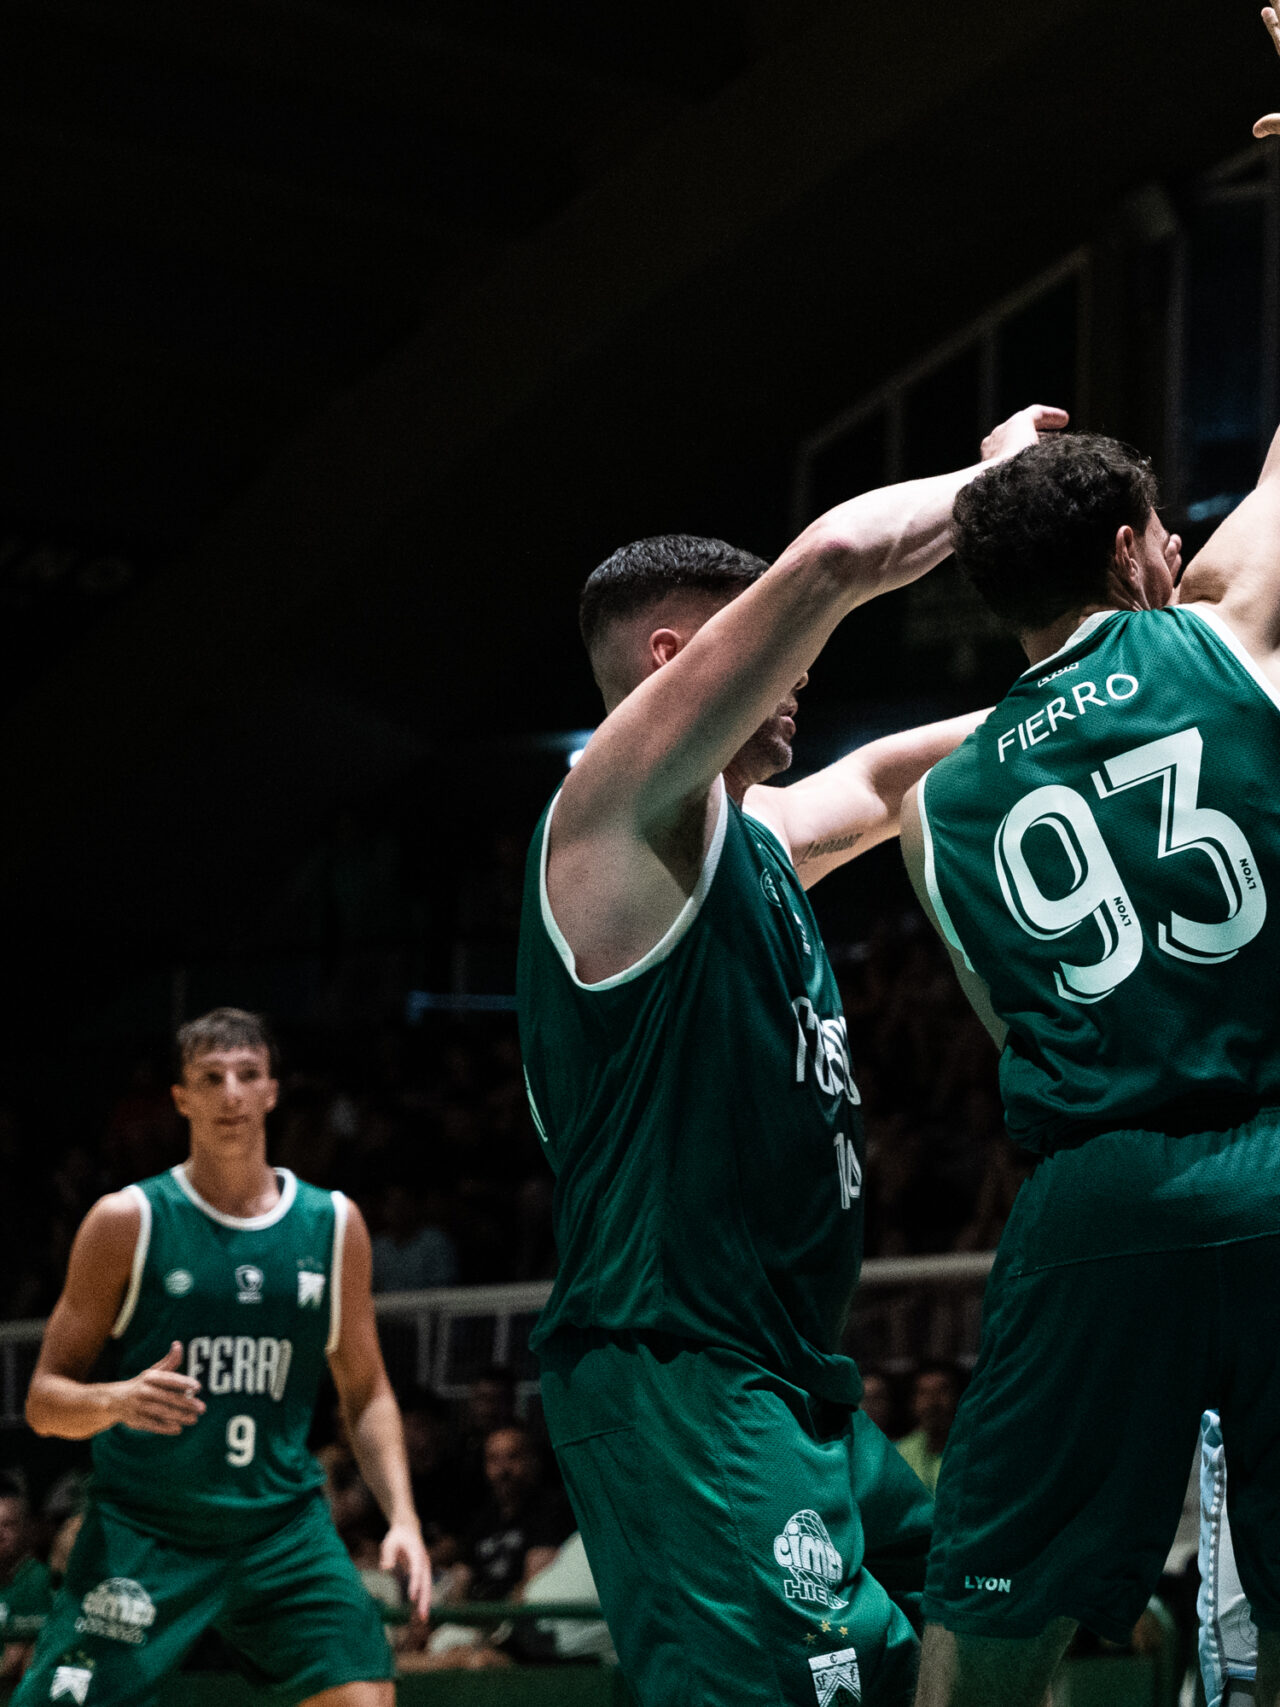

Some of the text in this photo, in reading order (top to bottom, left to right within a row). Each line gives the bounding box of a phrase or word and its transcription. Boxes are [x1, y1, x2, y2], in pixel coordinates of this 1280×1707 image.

[997, 673, 1140, 763] FIERRO
[994, 726, 1267, 1005] 93
[1239, 858, 1257, 890] LYON
[1113, 896, 1132, 927] LYON
[225, 1414, 256, 1468] 9
[964, 1575, 1012, 1593] LYON
